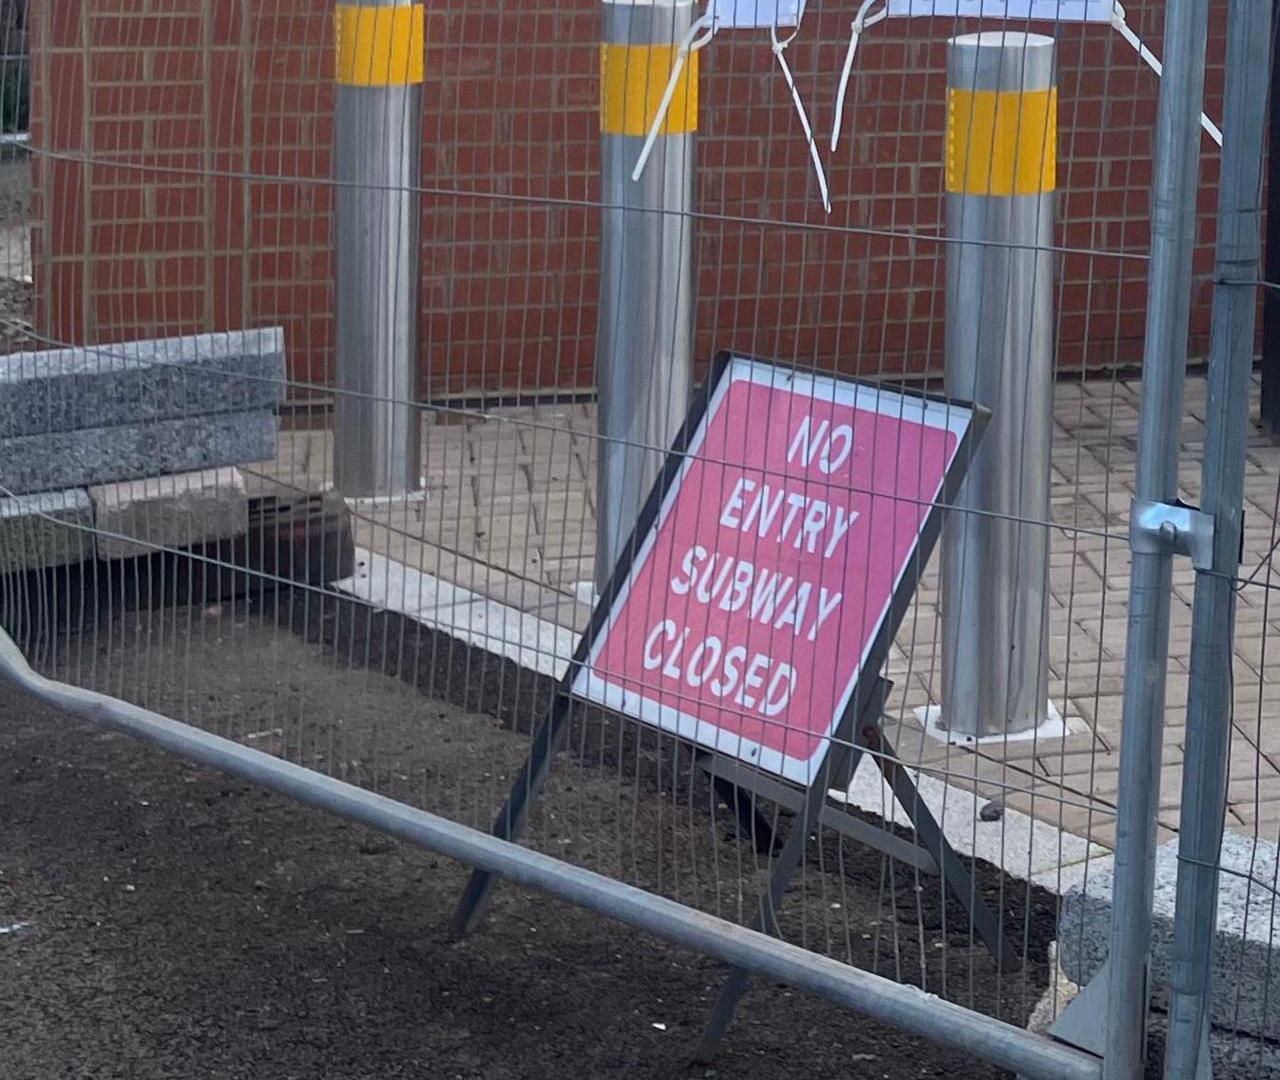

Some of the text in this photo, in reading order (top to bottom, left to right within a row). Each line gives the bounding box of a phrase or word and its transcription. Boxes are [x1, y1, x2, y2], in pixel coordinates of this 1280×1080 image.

[787, 415, 854, 474] NO
[719, 477, 860, 559] ENTRY
[670, 545, 843, 642] SUBWAY
[643, 619, 797, 717] CLOSED
